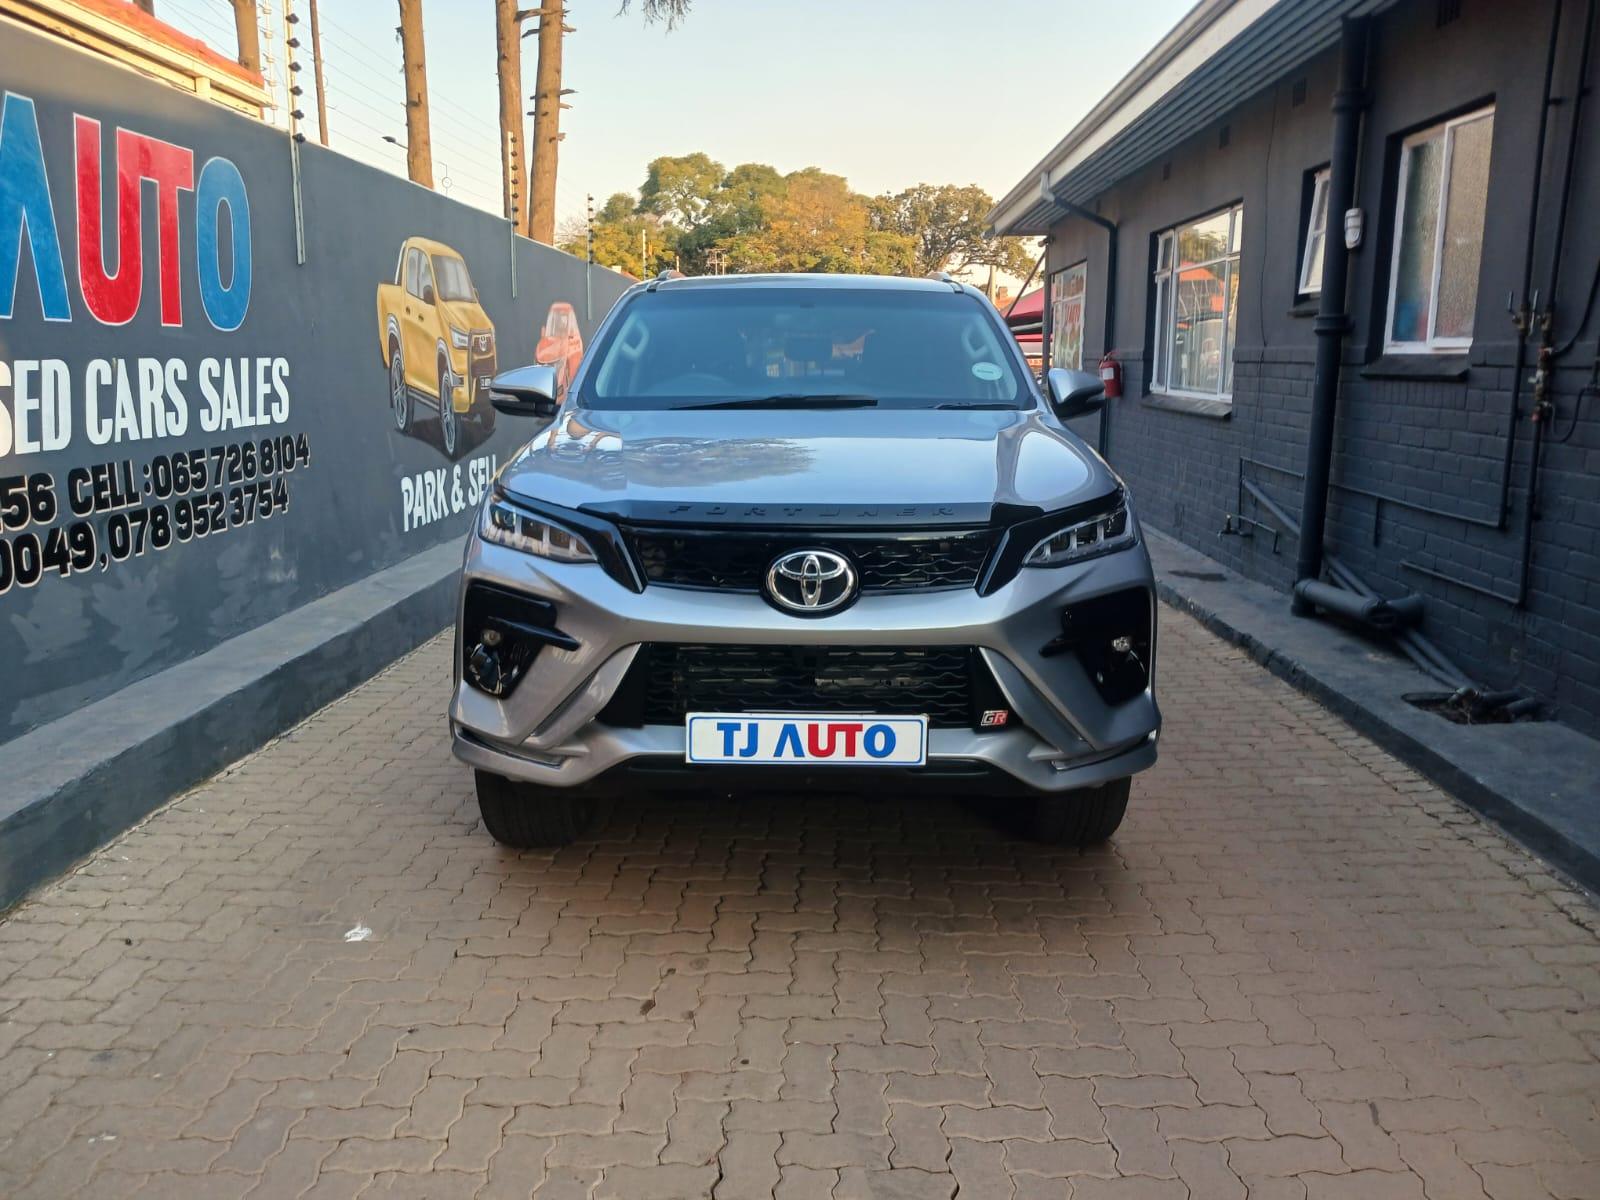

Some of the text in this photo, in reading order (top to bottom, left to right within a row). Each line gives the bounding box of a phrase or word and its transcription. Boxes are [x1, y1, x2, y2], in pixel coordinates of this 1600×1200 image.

[0, 90, 252, 332] AUTO
[85, 358, 188, 445] CARS
[199, 357, 290, 432] SALES
[0, 472, 57, 534] 56
[401, 467, 450, 532] PARK
[451, 464, 466, 514] &
[716, 722, 897, 758] TJ AUTO
[982, 710, 1009, 726] GR
